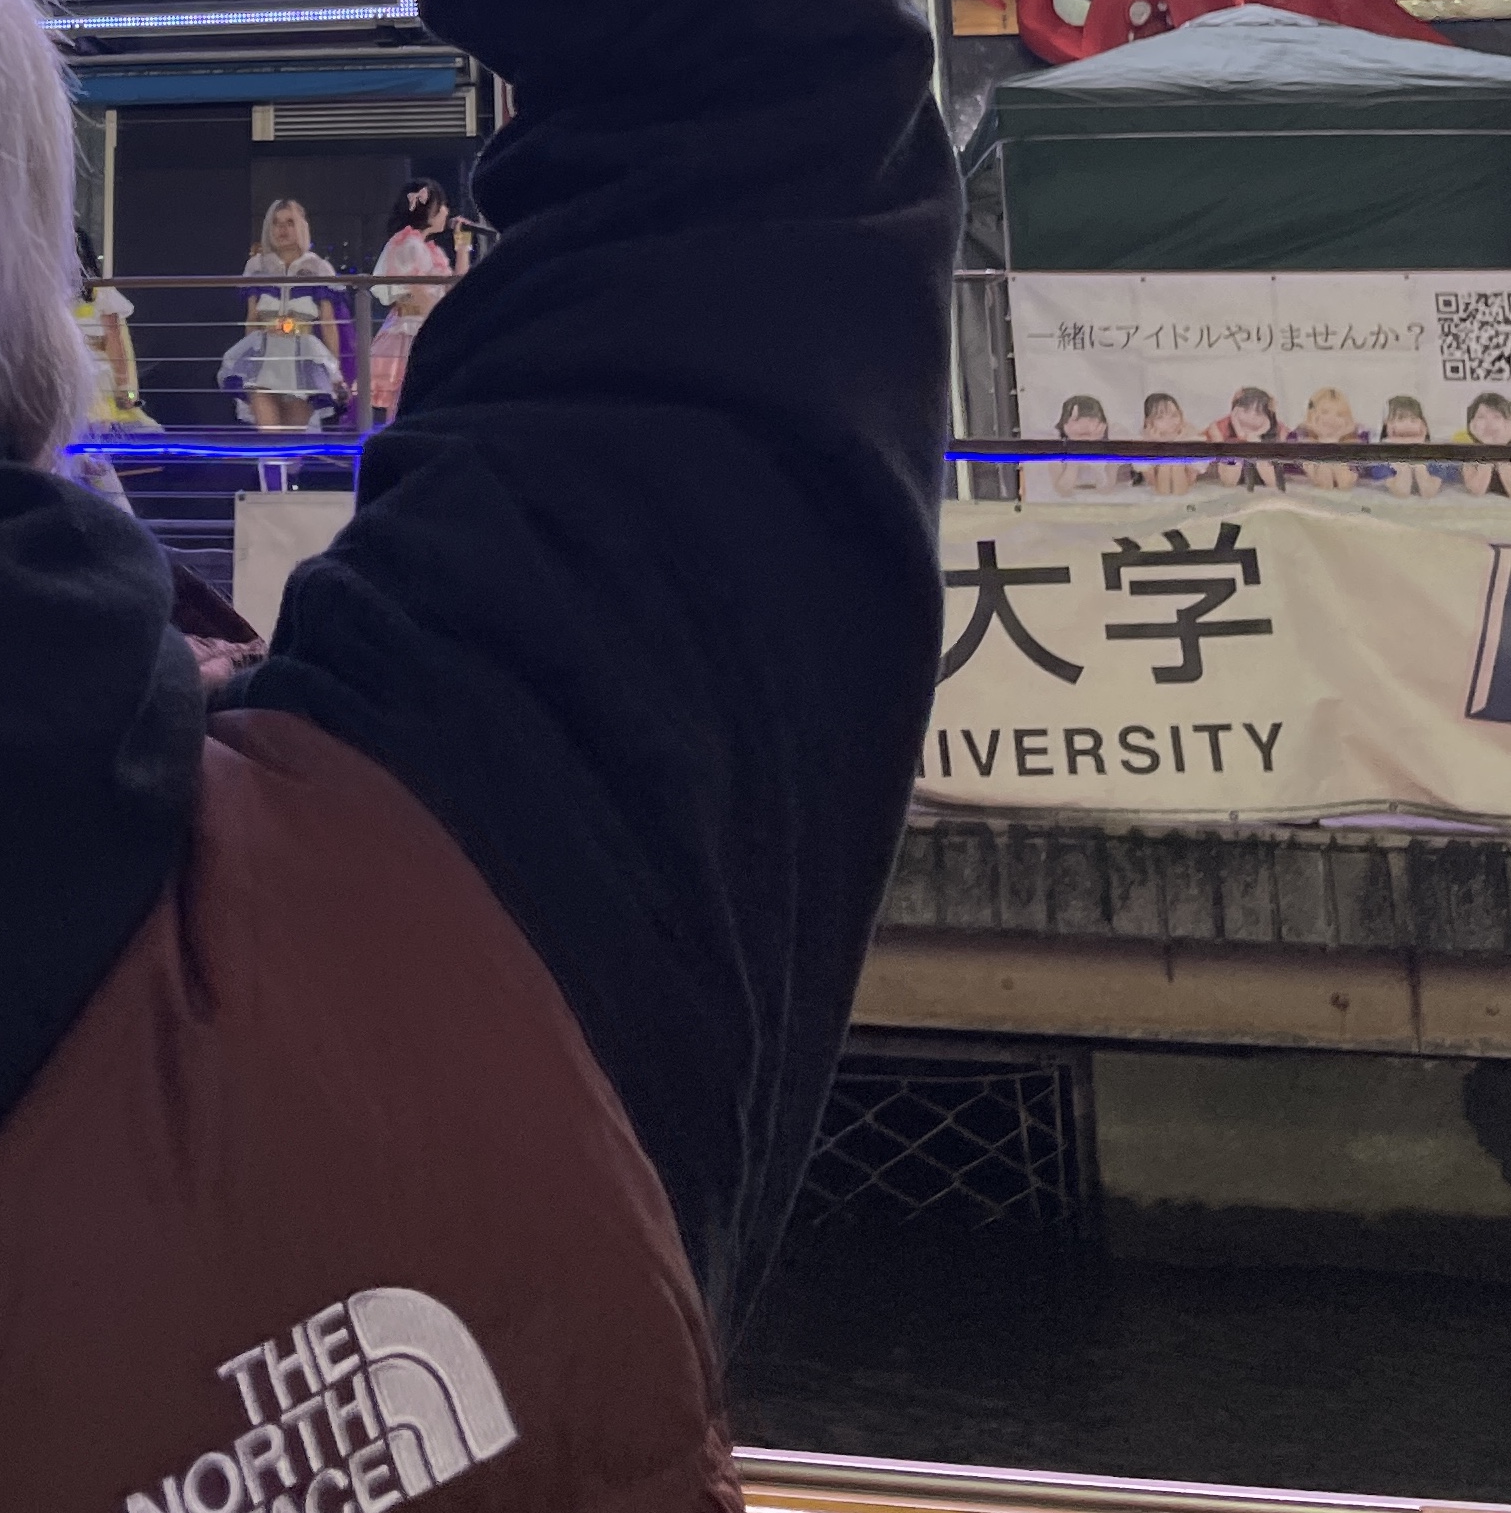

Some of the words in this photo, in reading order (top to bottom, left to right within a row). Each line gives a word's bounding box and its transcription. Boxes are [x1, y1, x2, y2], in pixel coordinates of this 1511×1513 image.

[1027, 321, 1425, 354] 一緒にアイドルやりませんか？
[937, 522, 1273, 686] 大学
[917, 721, 1283, 779] IVERSITY
[216, 1301, 361, 1425] THE
